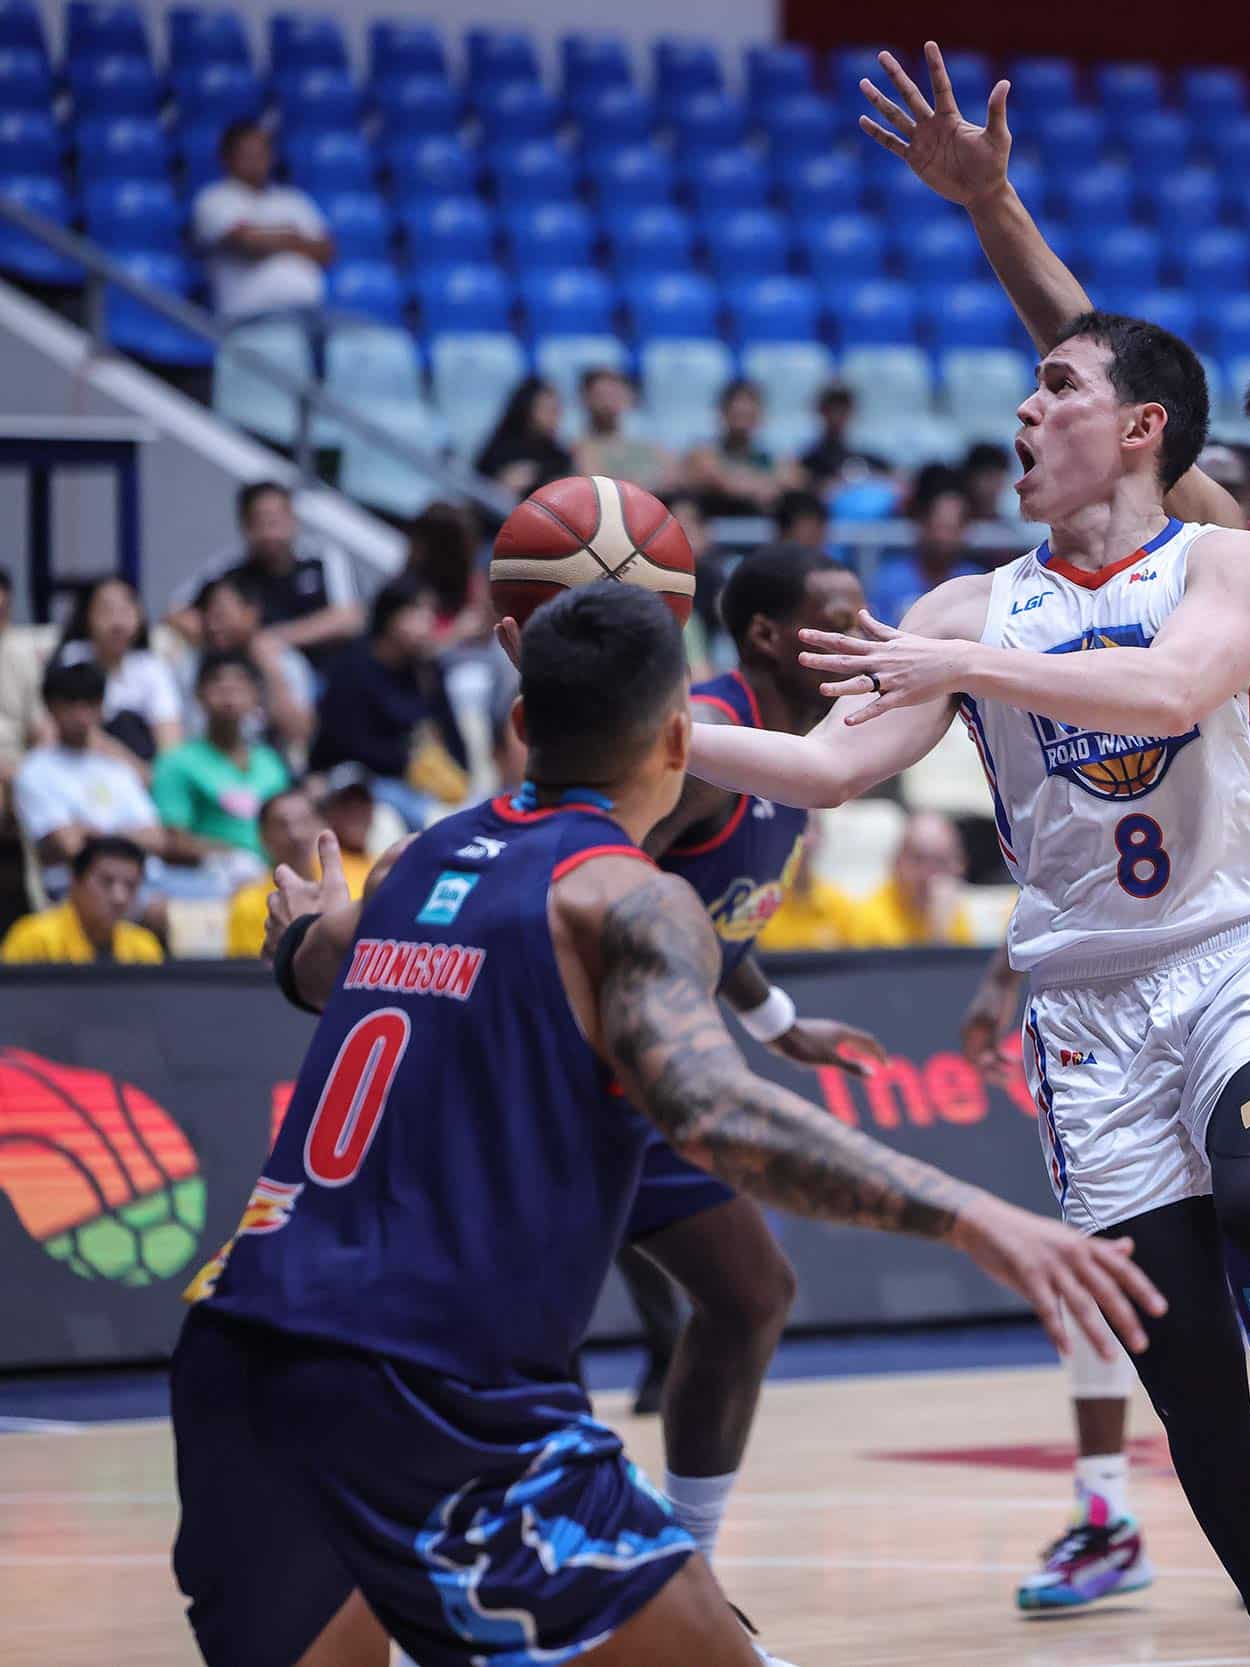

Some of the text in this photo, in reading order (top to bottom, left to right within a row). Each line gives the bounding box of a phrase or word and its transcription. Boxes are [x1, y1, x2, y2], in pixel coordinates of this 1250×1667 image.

[1046, 738, 1090, 769] ROAD
[1114, 812, 1171, 899] 8
[344, 938, 487, 1002] TIONGSON
[303, 1006, 412, 1189] 0
